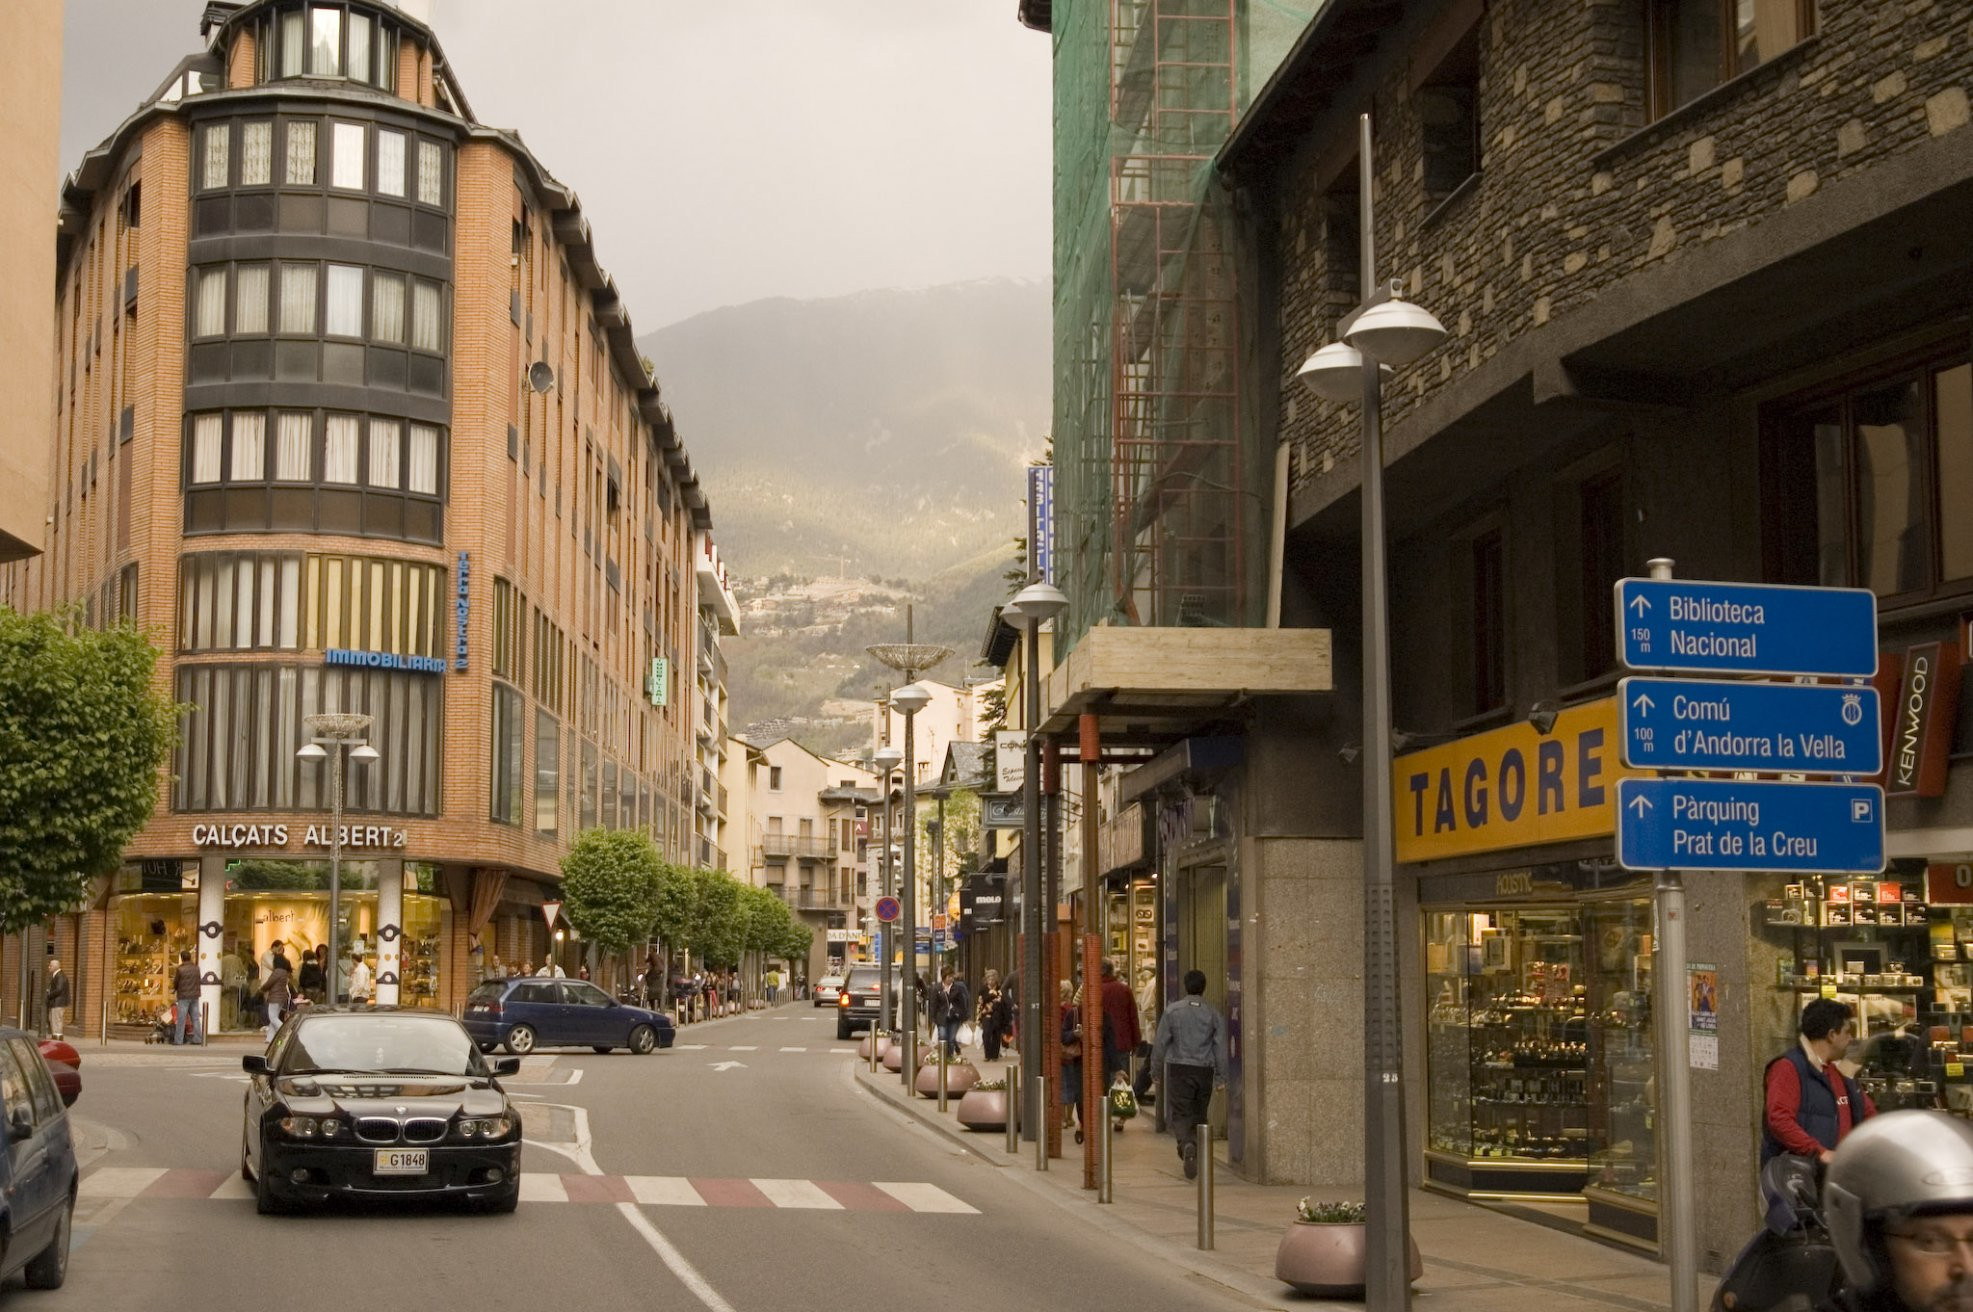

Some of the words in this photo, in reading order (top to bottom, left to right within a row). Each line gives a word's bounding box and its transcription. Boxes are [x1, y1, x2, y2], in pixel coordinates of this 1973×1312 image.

[1669, 596, 1765, 624] Biblioteca
[1631, 628, 1650, 641] 150
[1640, 643, 1650, 653] m
[1670, 630, 1757, 657] Nacional
[1673, 694, 1731, 721] Comú
[1898, 656, 1929, 786] KENWOOD
[1634, 727, 1654, 741] 100
[1643, 742, 1654, 753] m
[1778, 733, 1795, 758] la
[1800, 734, 1846, 759] Vella
[1410, 727, 1605, 837] TAGORE
[1673, 795, 1759, 826] Pàrquing
[192, 824, 289, 848] CALÇATS
[303, 824, 393, 847] ALBERT
[1673, 829, 1714, 855] Prat
[1719, 831, 1743, 855] de
[1750, 832, 1766, 856] la
[1772, 831, 1817, 857] Creu
